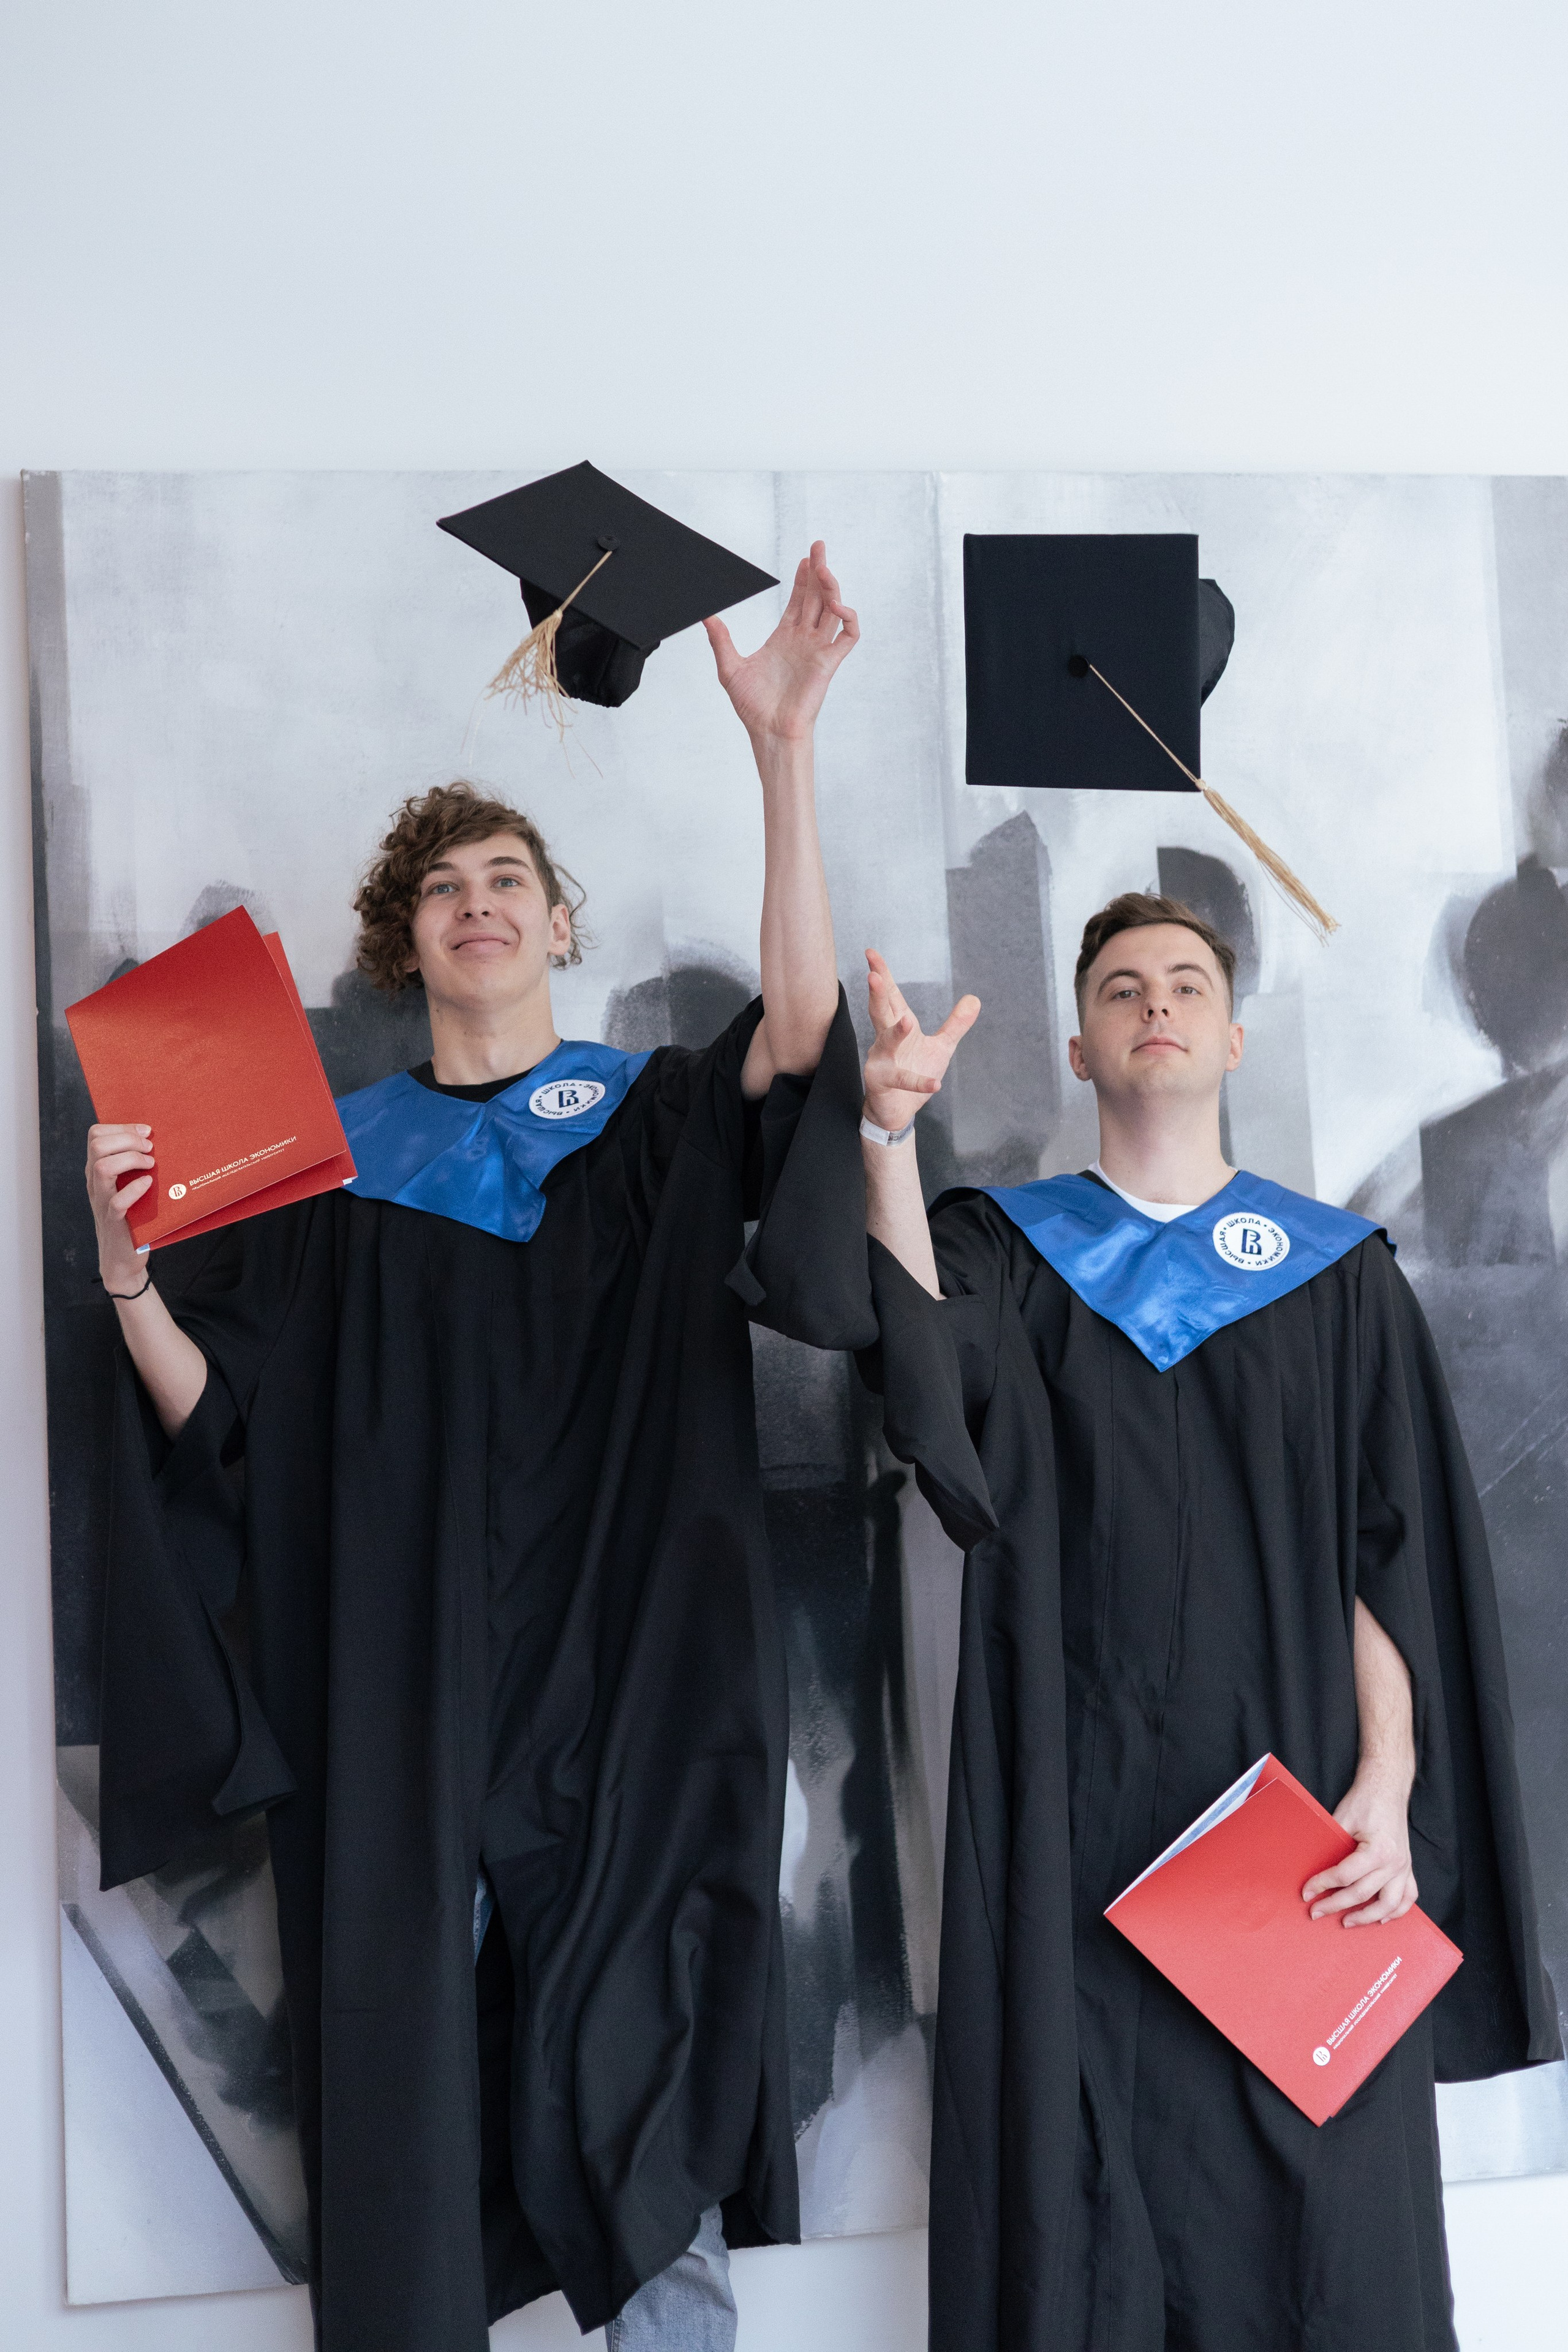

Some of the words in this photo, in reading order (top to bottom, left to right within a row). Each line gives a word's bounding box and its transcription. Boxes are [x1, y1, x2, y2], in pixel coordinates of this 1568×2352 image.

[541, 1082, 576, 1095] ШКОЛА
[573, 1084, 599, 1112] ЭКОНОМИКИ
[535, 1099, 563, 1115] ВЫСШАЯ
[189, 1168, 221, 1186] ВЫСШАЯ
[221, 1157, 249, 1173] ШКОЛА
[249, 1136, 297, 1160] ЭКОНОМИКИ
[1226, 1217, 1261, 1227] ШКОЛА
[1219, 1231, 1245, 1264] ВЫСШАЯ
[1255, 1227, 1283, 1266] ЭКОНОМИКИ
[1326, 2017, 1351, 2046] ВЫСШАЯ
[1348, 1995, 1370, 2020] ШКОЛА
[1366, 1956, 1403, 1997] ЭКОНОМИКИ
